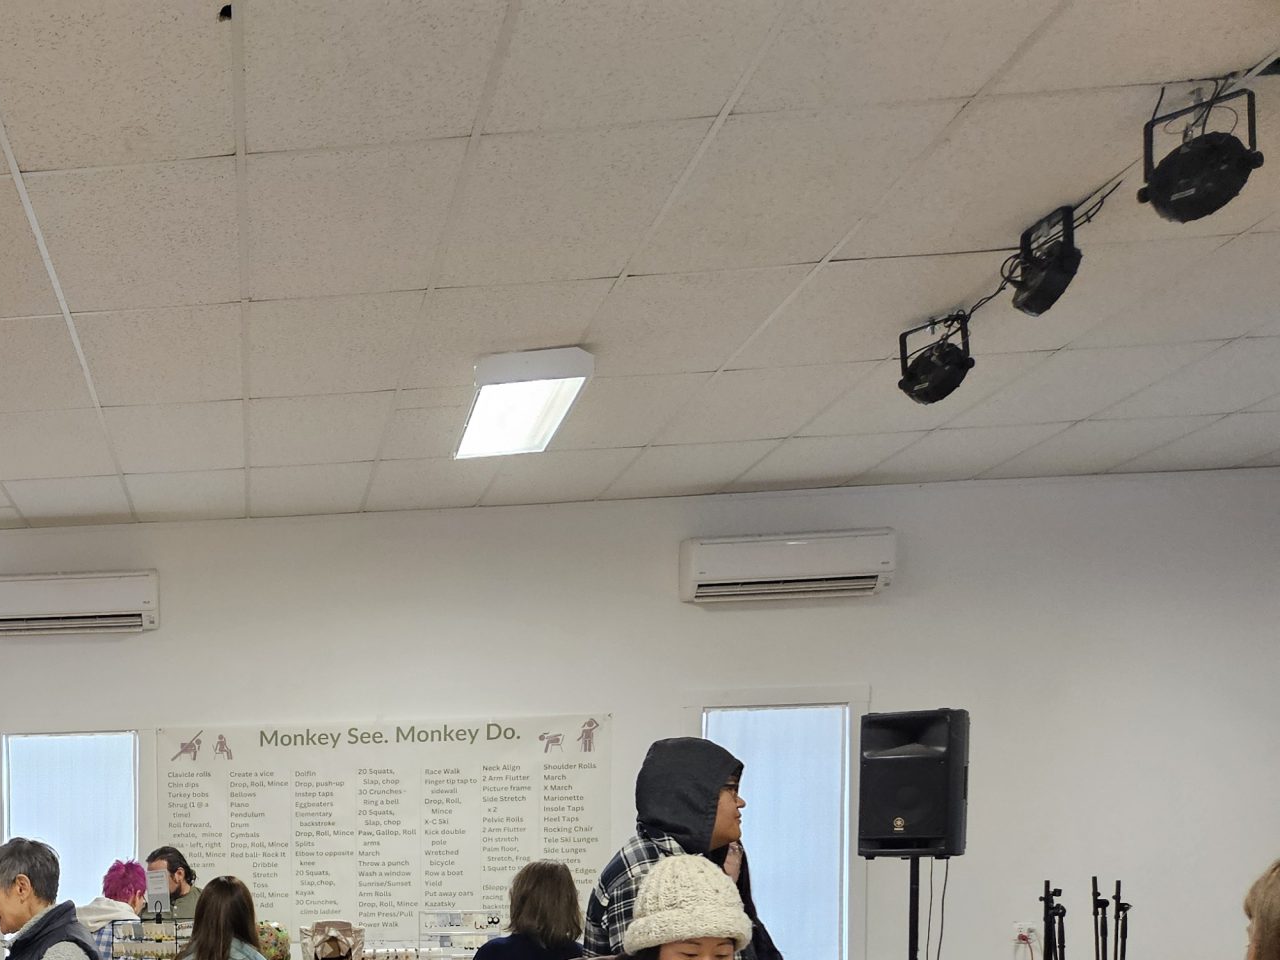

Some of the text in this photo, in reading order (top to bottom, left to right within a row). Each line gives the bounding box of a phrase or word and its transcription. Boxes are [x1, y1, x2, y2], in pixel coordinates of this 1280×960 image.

[259, 723, 521, 749] Monkey See. Monkey Do.
[482, 764, 521, 773] Neck Align
[543, 762, 577, 770] Shoulder
[196, 770, 212, 778] rolls
[229, 770, 253, 778] Create
[443, 767, 461, 775] Walk
[543, 773, 567, 781] March
[184, 781, 199, 790] dips
[267, 779, 289, 787] Mince
[315, 779, 345, 789] push-up
[381, 777, 400, 787] chop
[424, 778, 446, 787] Finger
[509, 784, 532, 792] frame
[168, 791, 191, 800] Turkey
[318, 790, 334, 799] taps
[543, 794, 584, 802] Marionette
[363, 798, 379, 807] Ring
[431, 807, 453, 815] Mince
[567, 804, 585, 814] Taps
[383, 818, 402, 828] chop
[562, 815, 579, 824] Taps
[168, 821, 182, 829] Roll
[503, 825, 526, 833] Flutter
[543, 825, 573, 835] Rocking
[229, 831, 260, 840] Cymbals
[295, 840, 315, 849] Splits
[431, 839, 447, 848] pole
[572, 836, 599, 845] Lunges
[204, 841, 222, 850] right
[560, 846, 587, 855] Lunges
[387, 859, 410, 869] punch
[487, 864, 508, 874] Squat
[575, 867, 597, 876] Edges
[358, 880, 412, 888] Sunrise/Sunset
[438, 891, 457, 899] away
[377, 910, 414, 918] Press/Pull
